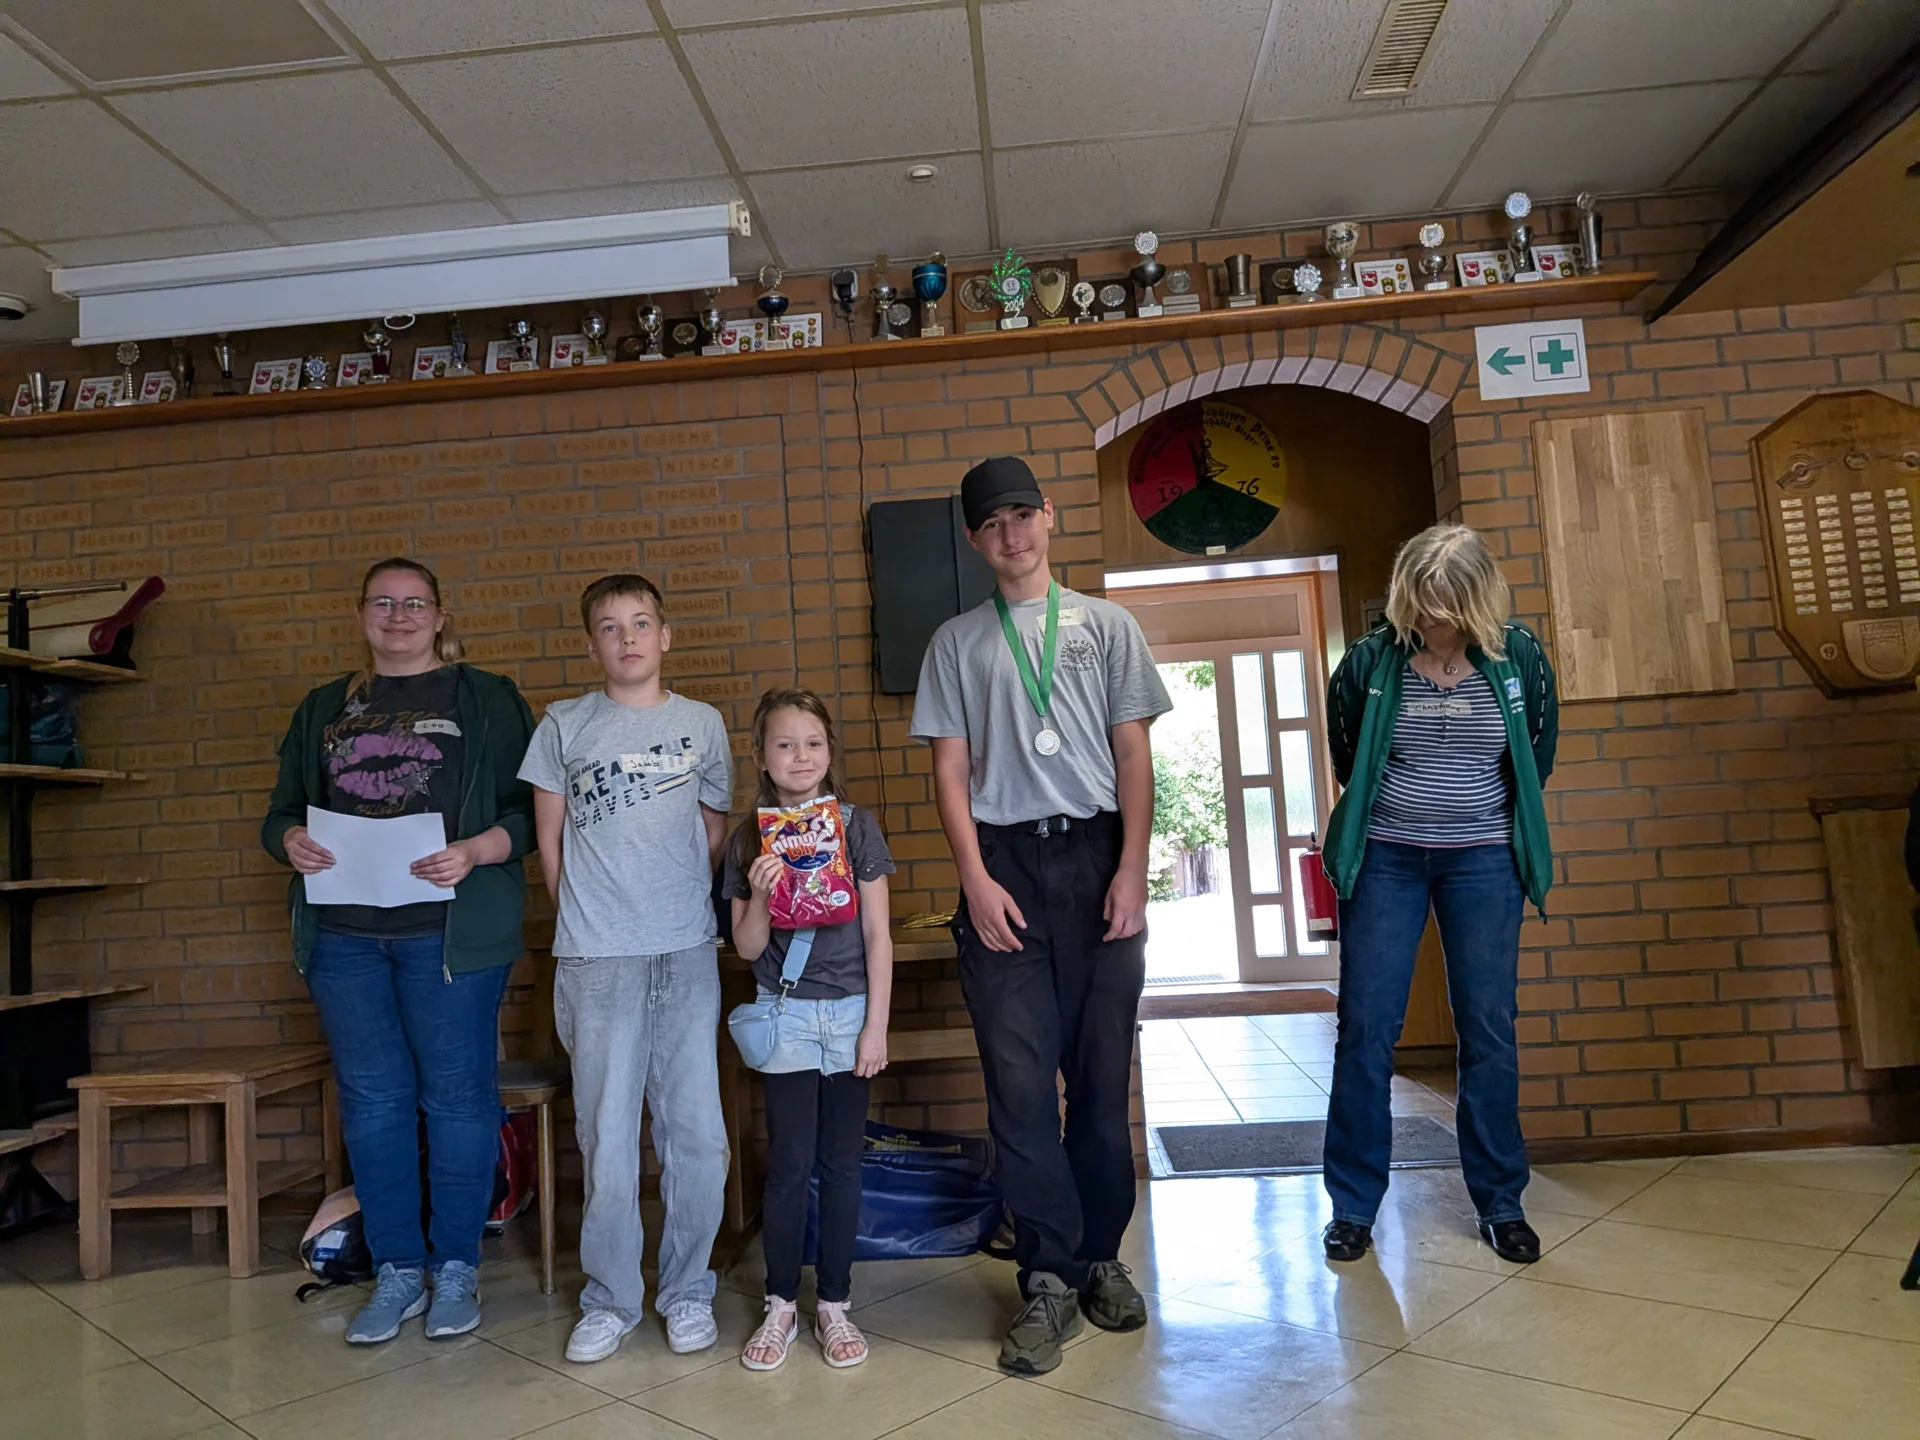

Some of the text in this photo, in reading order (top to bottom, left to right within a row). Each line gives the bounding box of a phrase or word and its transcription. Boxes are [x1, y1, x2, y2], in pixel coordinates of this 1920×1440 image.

[1004, 298, 1025, 312] 2004
[1237, 477, 1261, 496] 76
[664, 597, 725, 613] URKHARDT
[662, 654, 730, 671] CHELMANN
[770, 831, 818, 856] nimm
